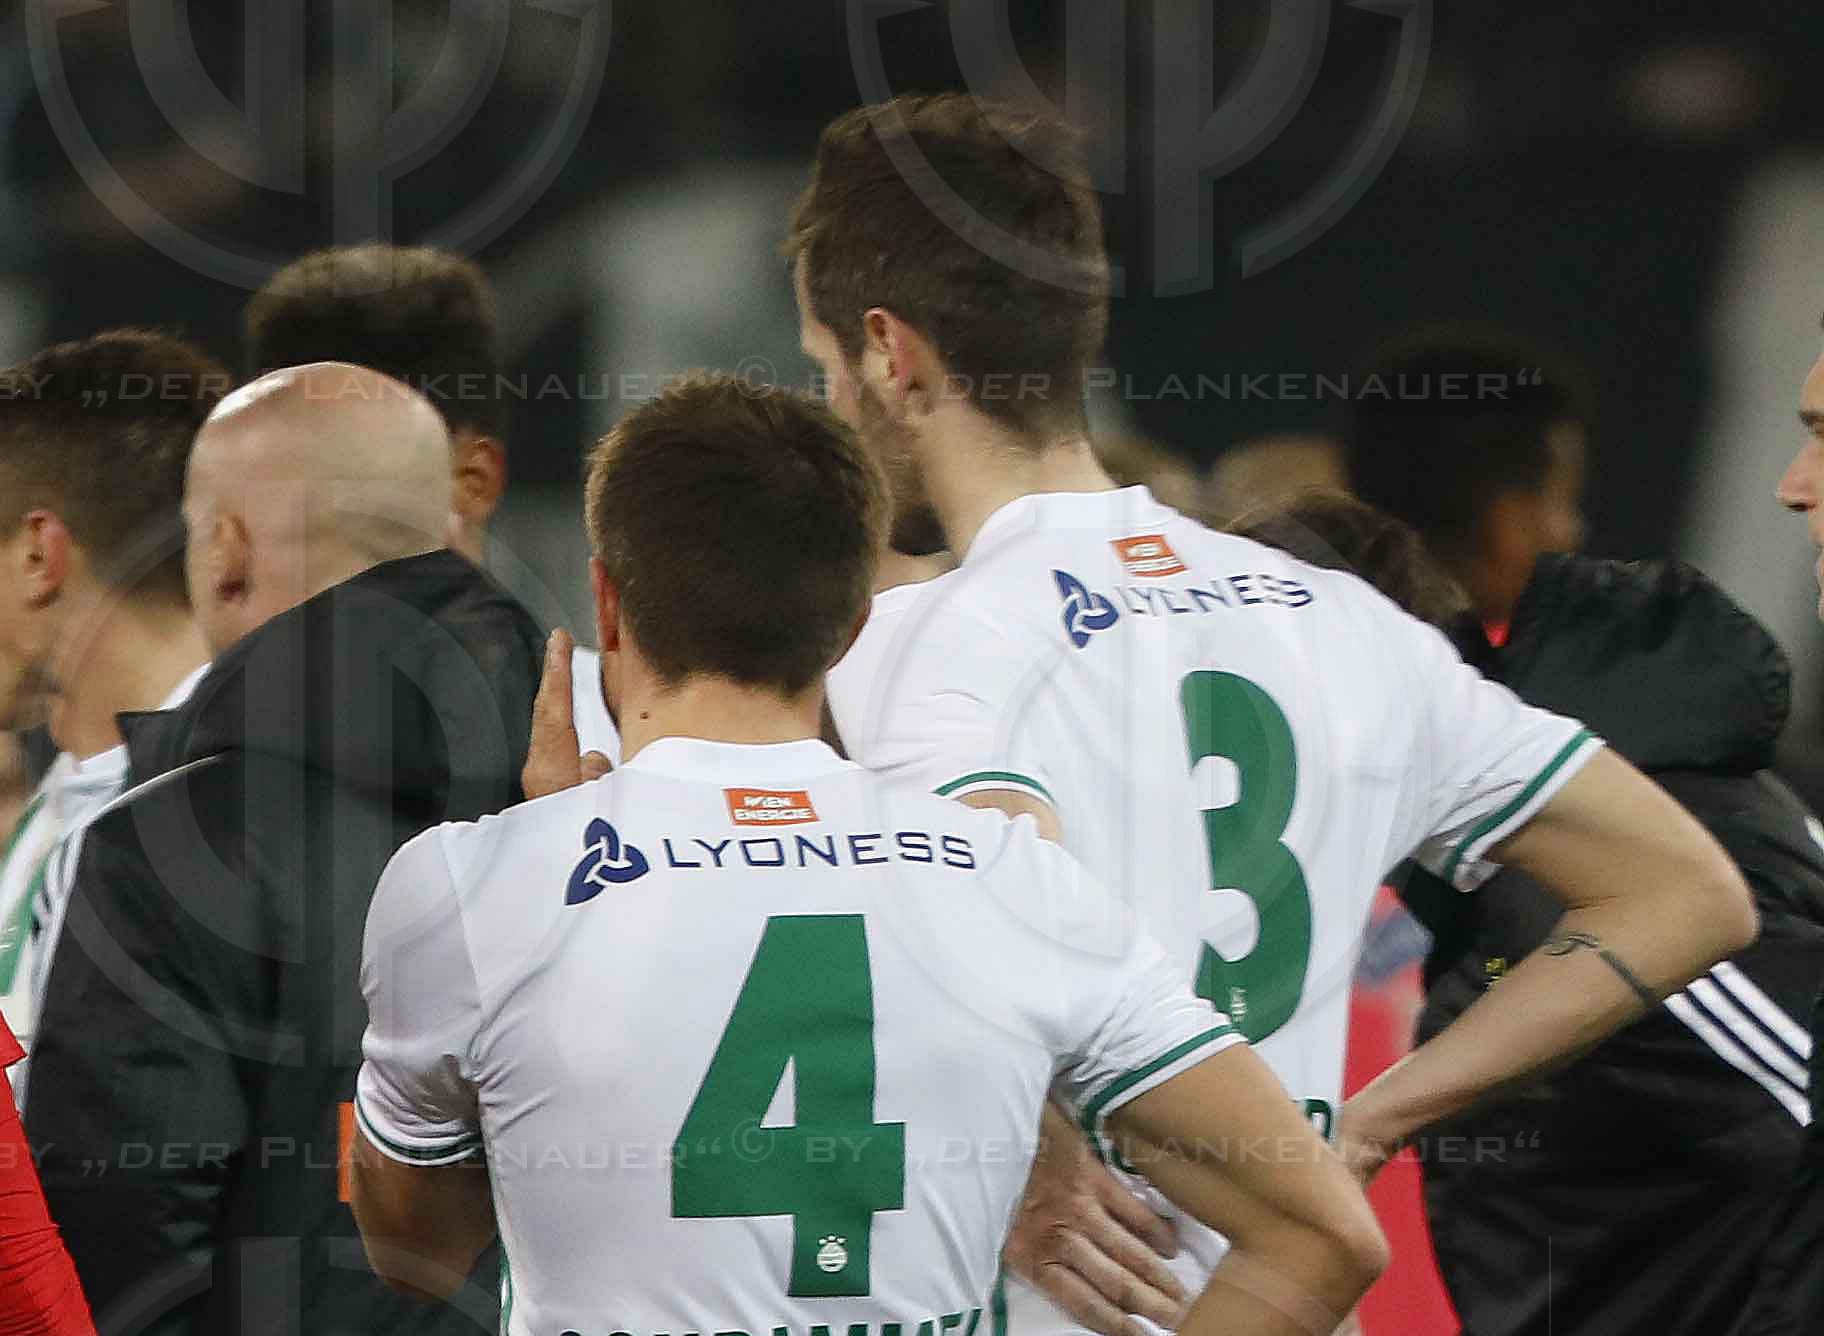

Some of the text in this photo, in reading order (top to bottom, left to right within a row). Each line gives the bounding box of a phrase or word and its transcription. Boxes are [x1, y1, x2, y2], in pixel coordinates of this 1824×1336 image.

[662, 831, 978, 870] LYONESS
[1179, 669, 1313, 1046] 3
[670, 912, 906, 1298] 4
